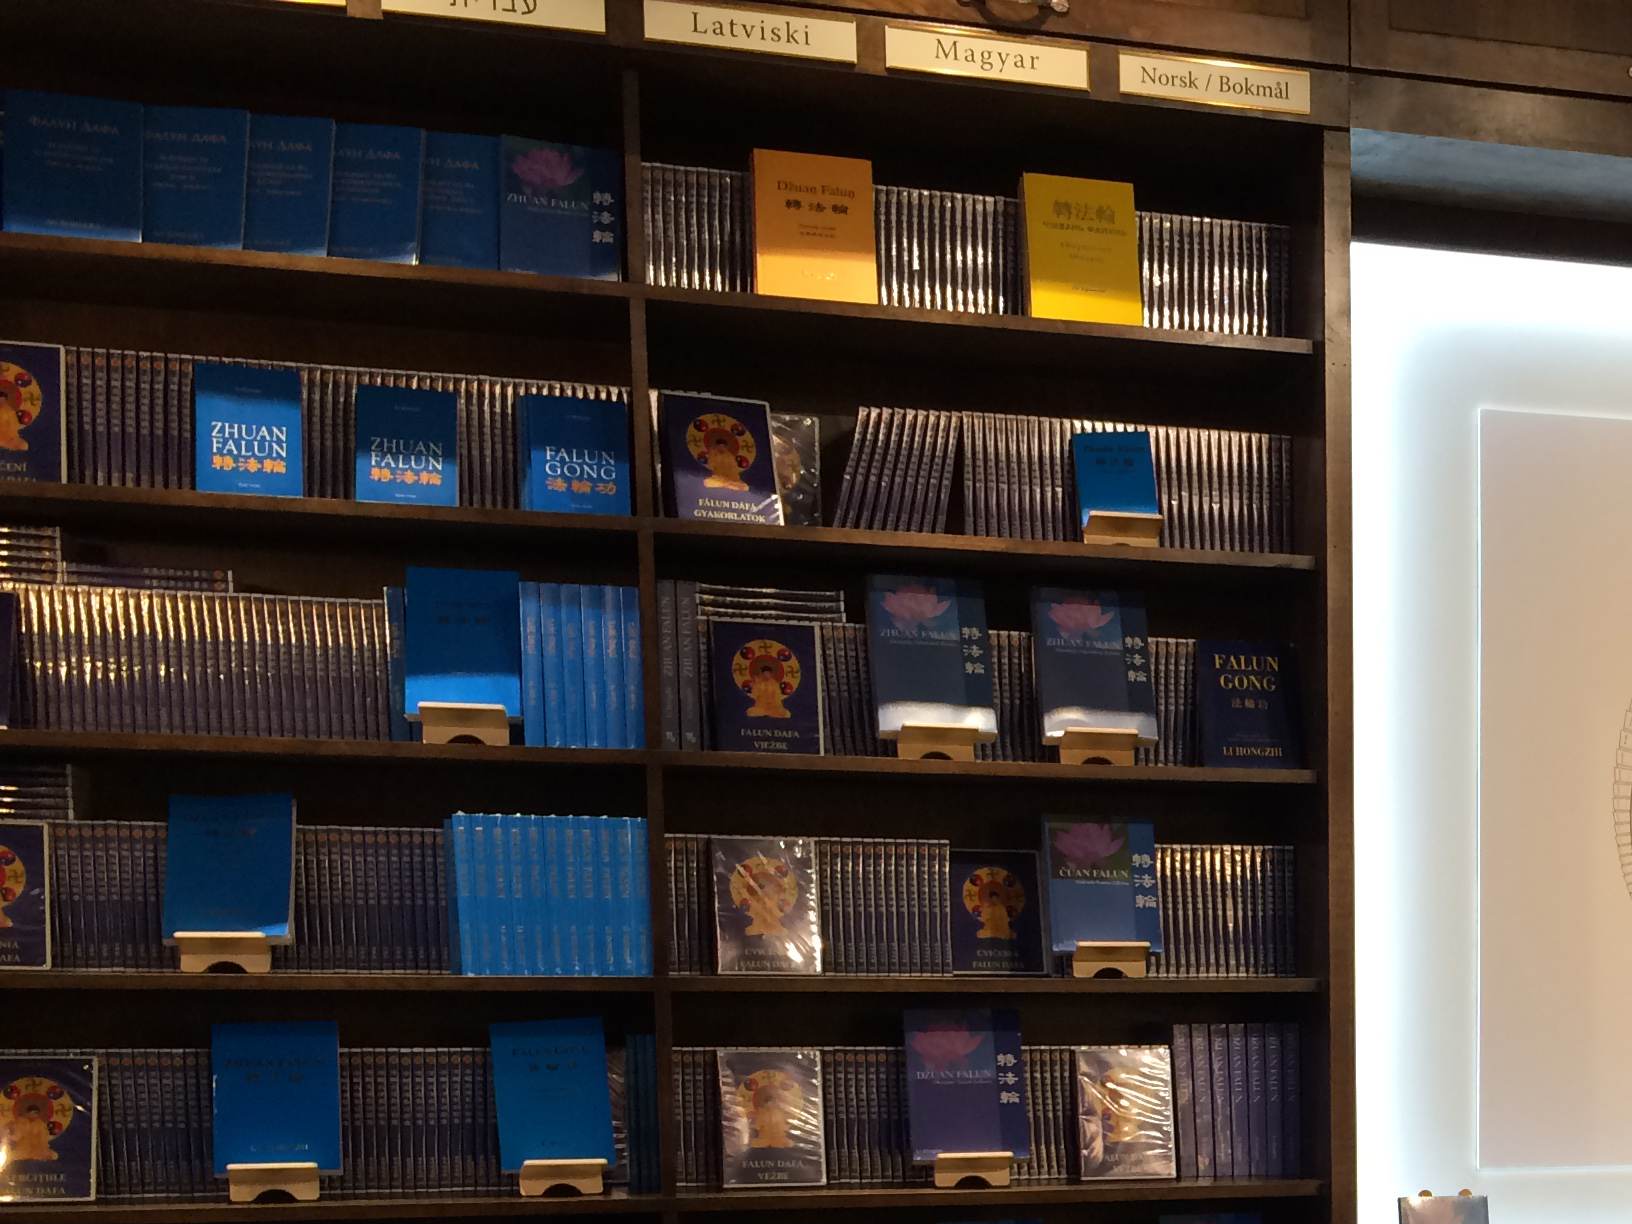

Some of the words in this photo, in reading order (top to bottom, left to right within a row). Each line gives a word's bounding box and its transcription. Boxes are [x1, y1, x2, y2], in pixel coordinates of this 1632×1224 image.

[691, 11, 810, 46] Latviski
[935, 38, 1040, 73] Magyar
[1140, 66, 1199, 90] Norsk
[1205, 74, 1213, 92] /
[1218, 75, 1290, 100] Bokmål
[211, 421, 287, 442] ZHUAN
[212, 438, 287, 458] FALUN
[371, 436, 442, 456] ZHUAN
[371, 451, 442, 471] FALUN
[545, 446, 615, 466] FALUN
[545, 461, 617, 480] GONG
[693, 510, 766, 523] GYAKORLATOK
[1213, 653, 1279, 672] FALUN
[1219, 674, 1276, 692] GONG
[741, 729, 772, 738] FALUN
[774, 730, 800, 739] DAFA
[1222, 745, 1235, 756] LI
[1238, 746, 1282, 757] HONGZHI
[1093, 868, 1128, 878] FALUN
[742, 1160, 774, 1169] FALUN
[777, 1160, 804, 1169] DAFA
